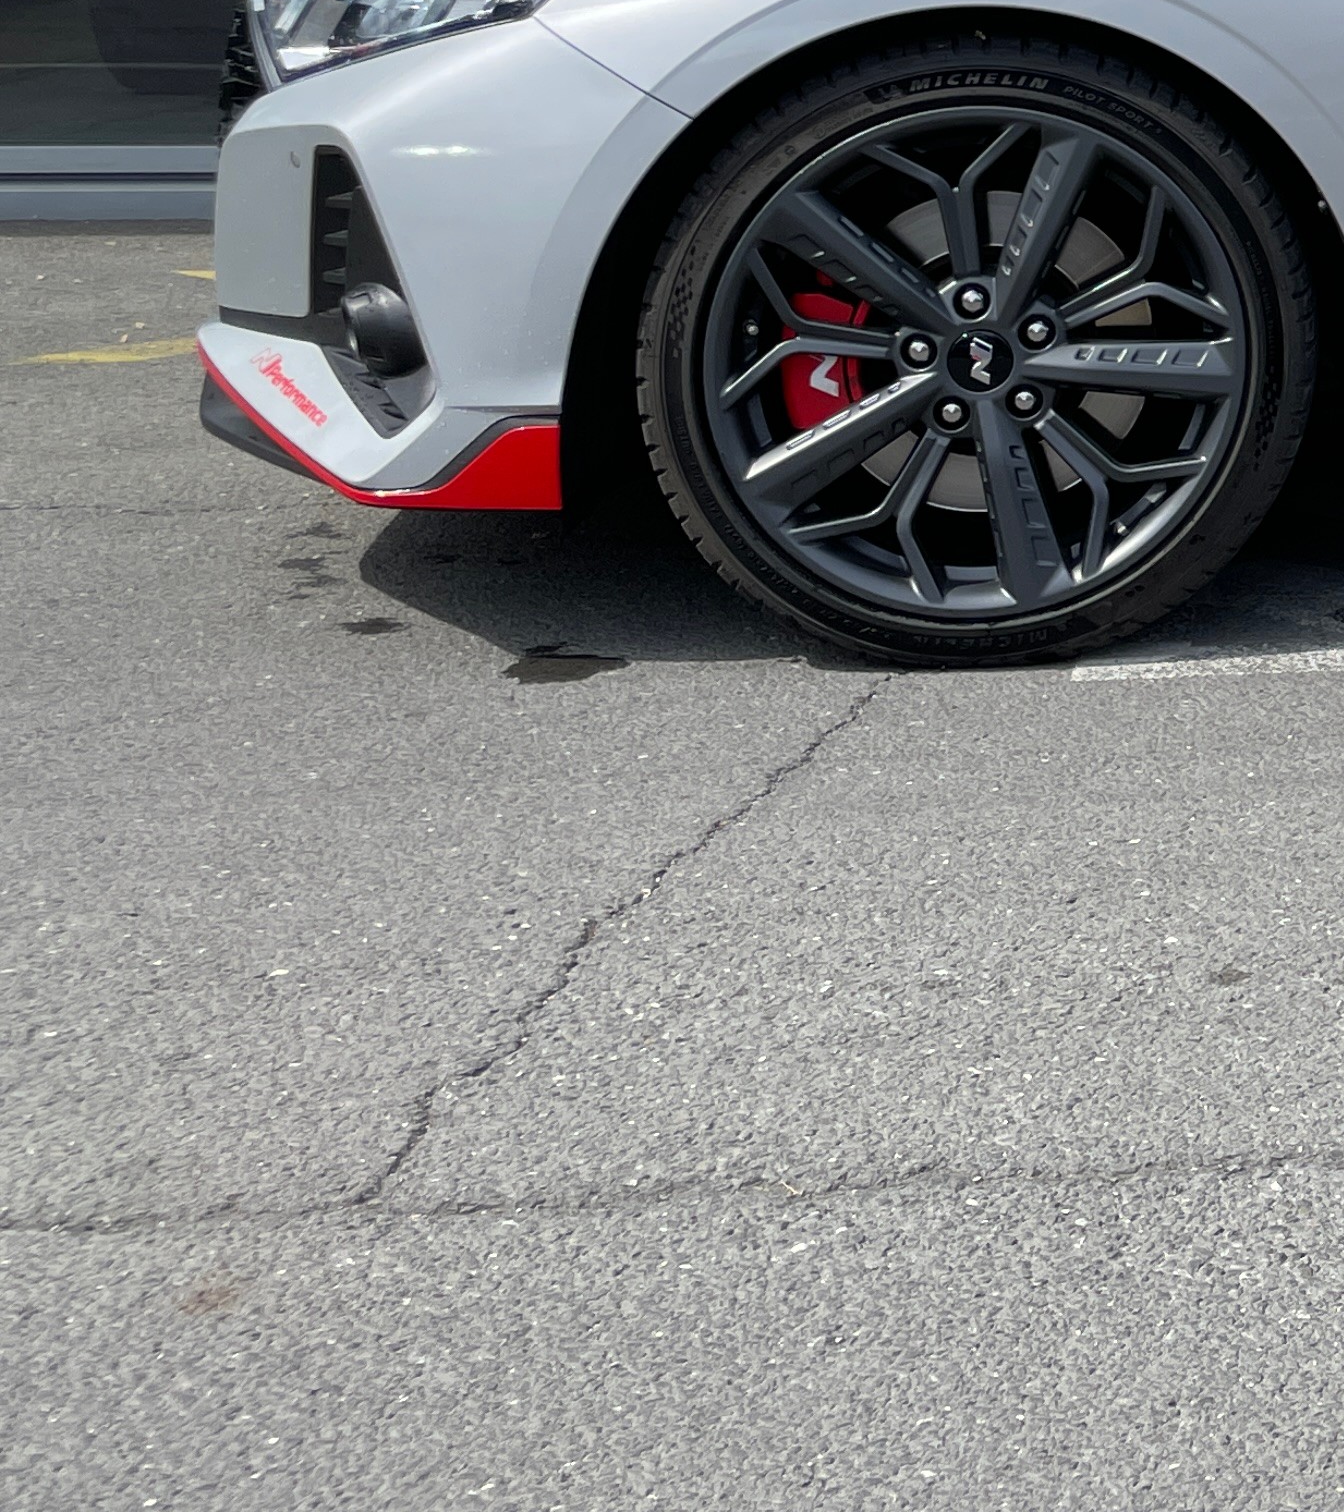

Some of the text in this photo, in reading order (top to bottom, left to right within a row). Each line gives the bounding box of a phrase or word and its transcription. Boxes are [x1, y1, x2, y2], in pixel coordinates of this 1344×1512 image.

[908, 72, 1154, 129] MICHELIN PILOT SPORT
[263, 360, 328, 428] Performance
